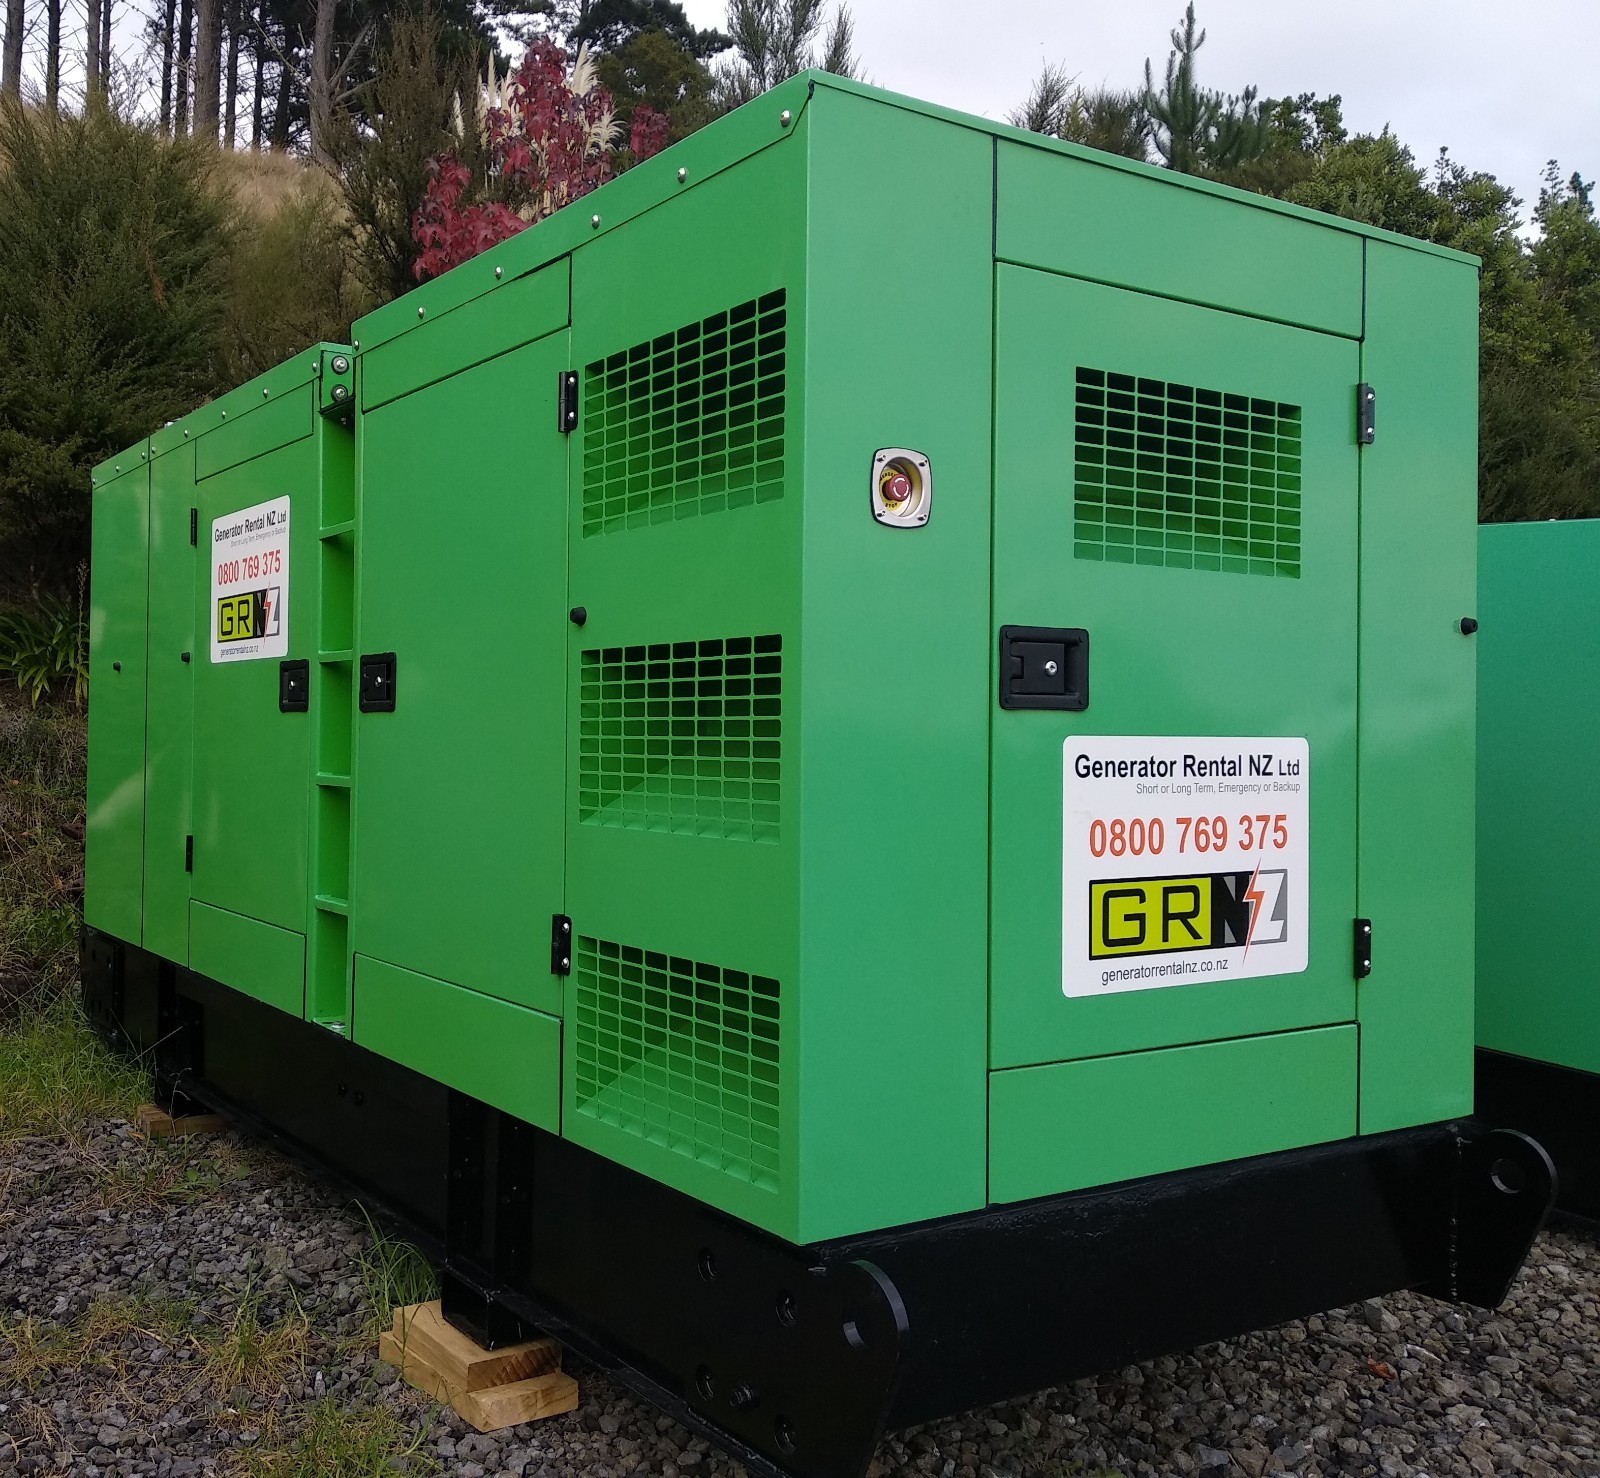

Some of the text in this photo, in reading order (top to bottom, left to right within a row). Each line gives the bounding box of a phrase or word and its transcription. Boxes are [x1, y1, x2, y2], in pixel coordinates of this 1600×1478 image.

[214, 523, 244, 543] Generator
[244, 513, 265, 534] Rental
[266, 510, 276, 527] NZ
[277, 510, 286, 523] Ltd
[218, 549, 281, 586] 0800 769 375
[1075, 753, 1300, 778] Generator Rental NZ Ltd
[1136, 781, 1301, 795] Short or Long Term, Emergency or Backup
[1089, 813, 1289, 858] 0800 769 375
[1101, 958, 1229, 986] generatorrentalnz.co.nz
